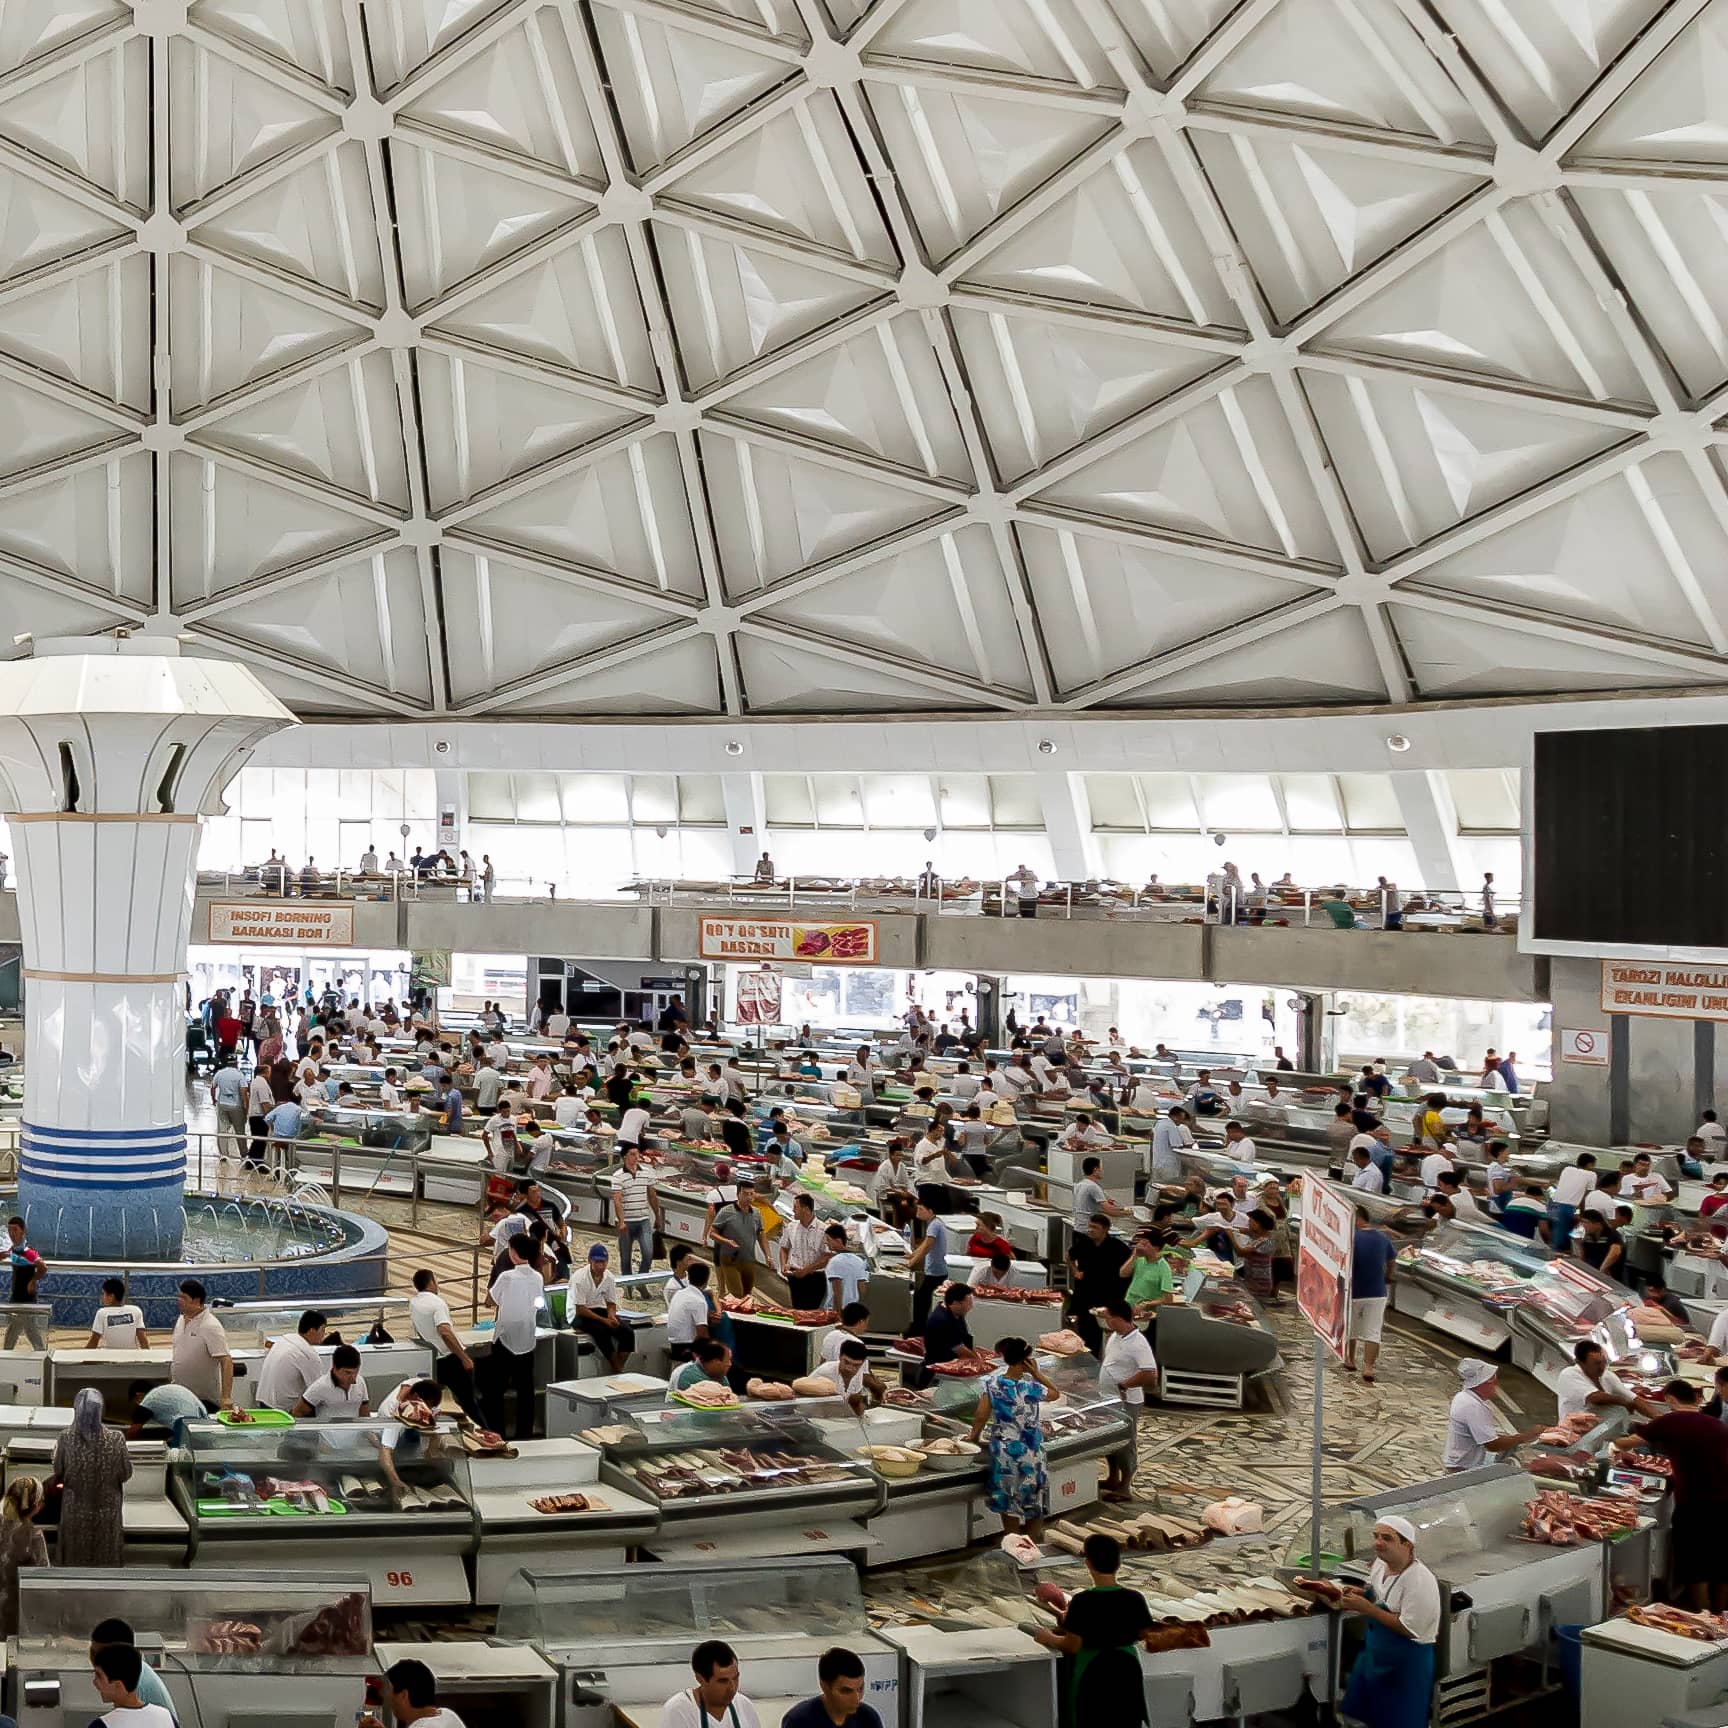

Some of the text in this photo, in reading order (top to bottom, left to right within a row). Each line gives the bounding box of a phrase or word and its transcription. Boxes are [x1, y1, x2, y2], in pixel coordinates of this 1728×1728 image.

[230, 911, 332, 923] INSOFI BORNING
[231, 925, 294, 937] BARAKASI
[386, 1572, 413, 1587] 96
